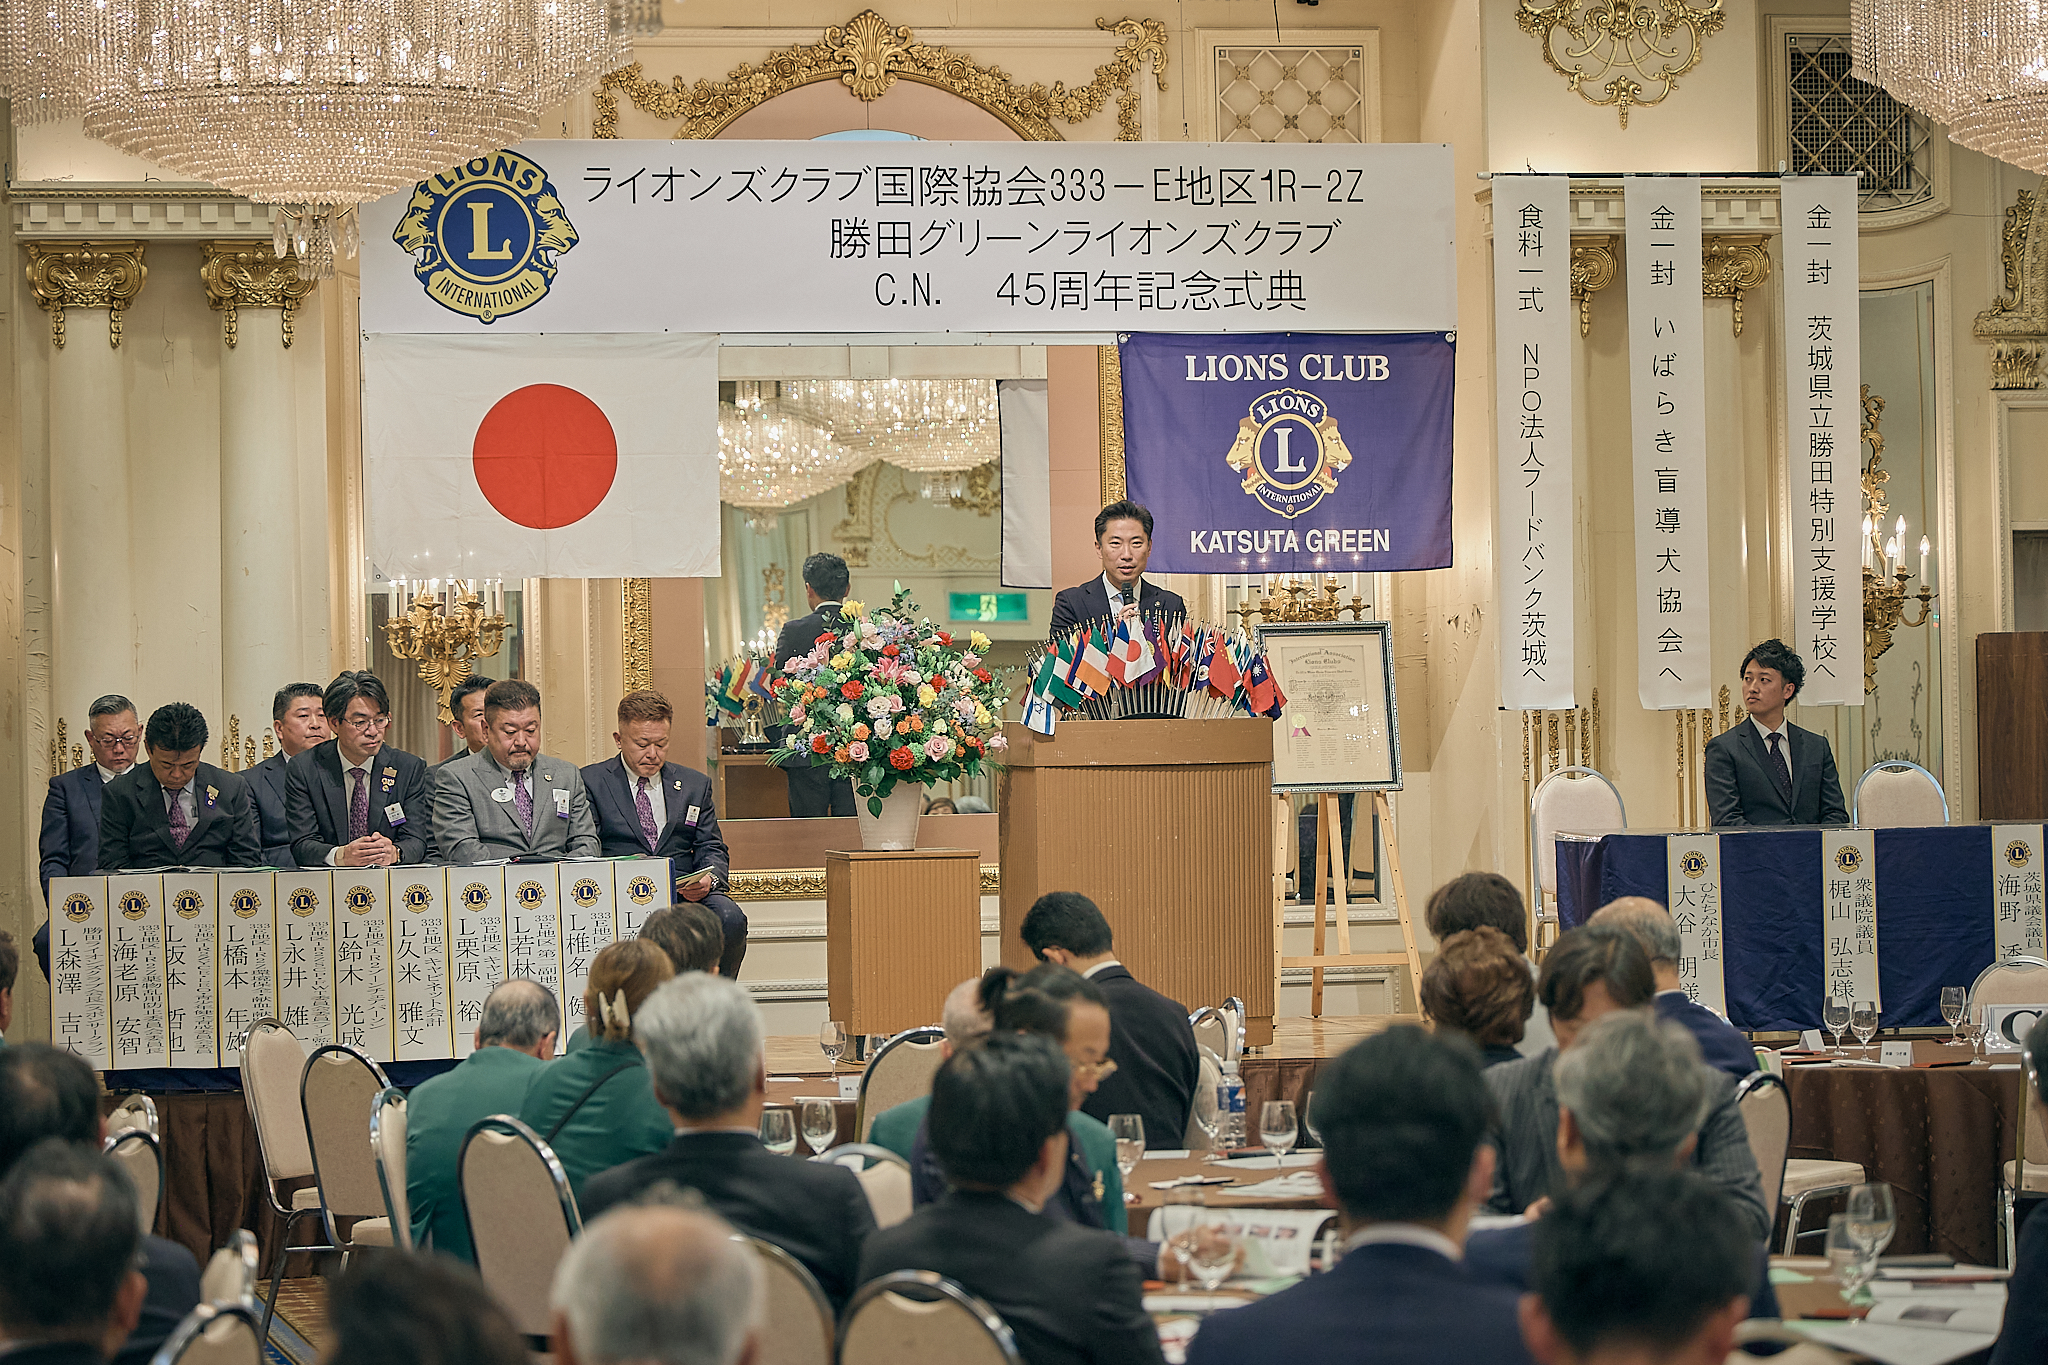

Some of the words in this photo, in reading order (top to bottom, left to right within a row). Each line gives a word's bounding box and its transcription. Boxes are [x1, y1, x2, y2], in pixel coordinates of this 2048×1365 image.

[434, 155, 538, 191] LIONS
[467, 203, 513, 260] L
[829, 218, 1342, 259] 勝田グリーンライオンズクラブ
[1518, 203, 1544, 313] 食料一式
[1650, 204, 1676, 286] 金一封
[1806, 203, 1832, 285] 金一封
[436, 276, 539, 309] INTERNATIONAL
[874, 271, 942, 307] C.N.
[995, 268, 1307, 312] 45周年記念式典
[1185, 353, 1289, 382] LIONS
[1299, 353, 1391, 382] CLUB
[1257, 394, 1321, 421] LIONS
[1273, 427, 1307, 473] L
[1257, 483, 1323, 505] INTERNATIONAL
[1519, 343, 1547, 682] NPO法人フードバンク茨城へ
[1653, 316, 1684, 682] いばらき盲導犬協会へ
[1807, 315, 1838, 678] 茨城県立勝田特別支援学校へ
[1189, 529, 1300, 554] KATSUTA
[1305, 528, 1391, 553] GREEN
[1674, 885, 1697, 935] 大谷
[1699, 882, 1719, 961] ひたちなか市長
[1828, 879, 1852, 921] 梶山
[1854, 877, 1874, 955] 衆議院議員
[1998, 873, 2021, 923] 海野
[2023, 871, 2043, 949] 茨城県議会議員
[55, 929, 82, 994] L森澤
[112, 926, 140, 1002] L海老原
[166, 925, 187, 990] L坂本
[223, 924, 249, 990] L橋本
[282, 923, 308, 989] L永井
[338, 921, 363, 986] L鈴木
[397, 920, 421, 984] L久米
[455, 918, 481, 982] L栗原
[480, 917, 502, 994] 333E地区キャビネ
[510, 916, 537, 979] L若林
[566, 913, 591, 978] L椎名
[1830, 937, 1855, 998] 弘志様
[58, 1012, 83, 1056] 吉大
[116, 1016, 141, 1055] 安智
[169, 1008, 187, 1052] 哲也
[341, 1004, 365, 1047] 光成
[398, 1002, 424, 1047] 雅文
